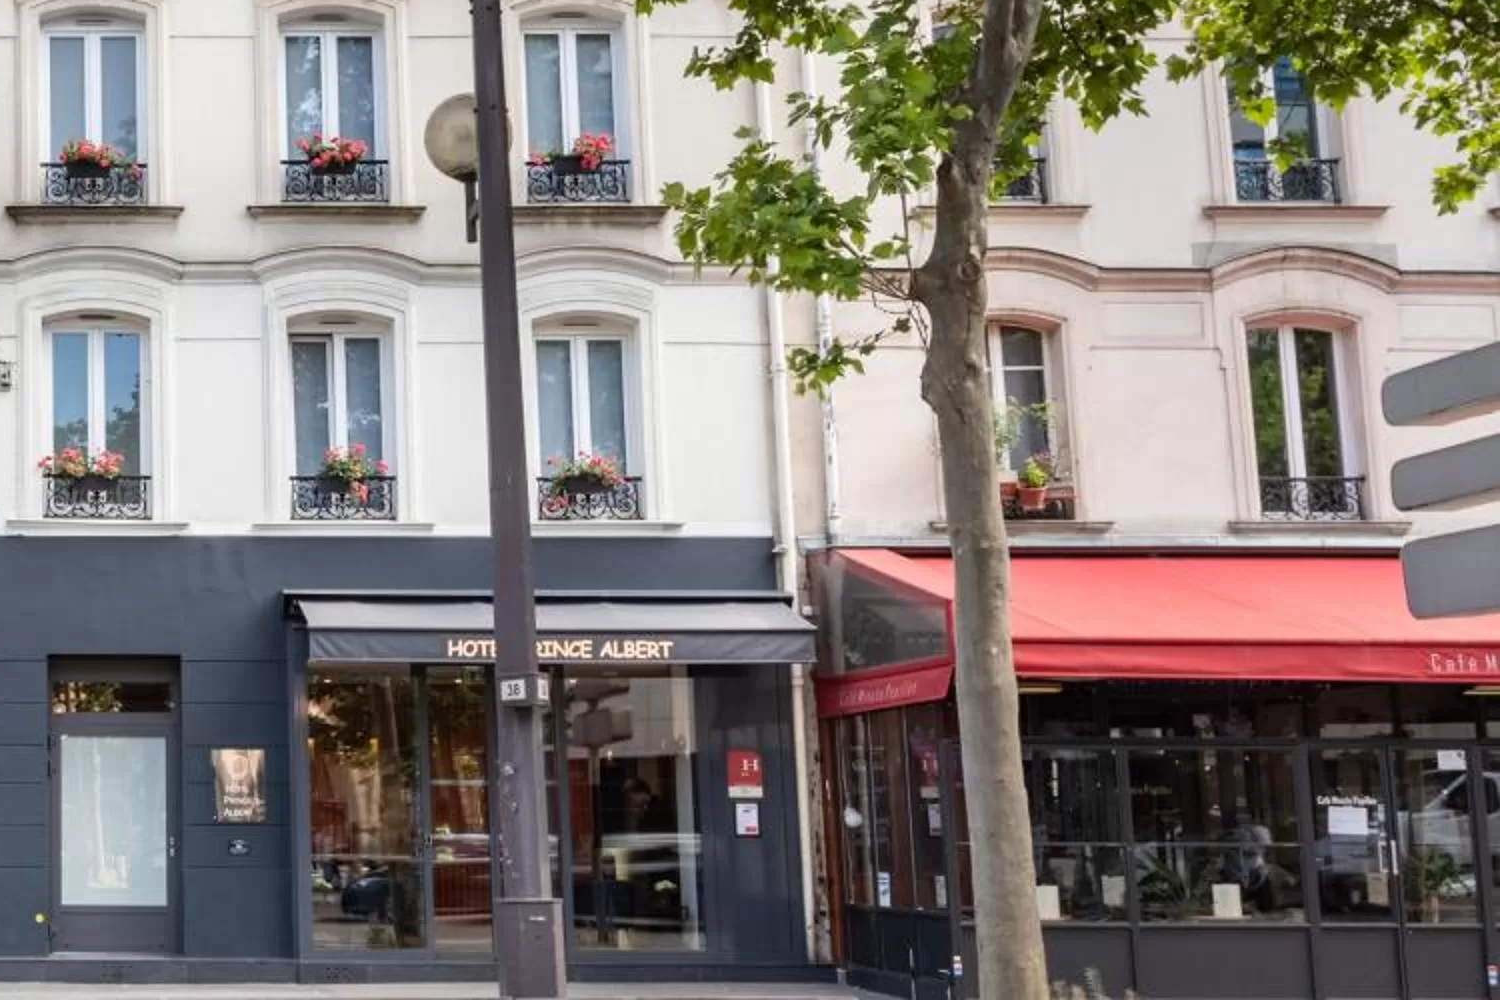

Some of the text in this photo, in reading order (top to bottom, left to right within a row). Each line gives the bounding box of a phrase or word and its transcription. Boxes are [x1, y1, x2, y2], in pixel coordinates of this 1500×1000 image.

[447, 639, 674, 658] HOT RINCE ALBERT
